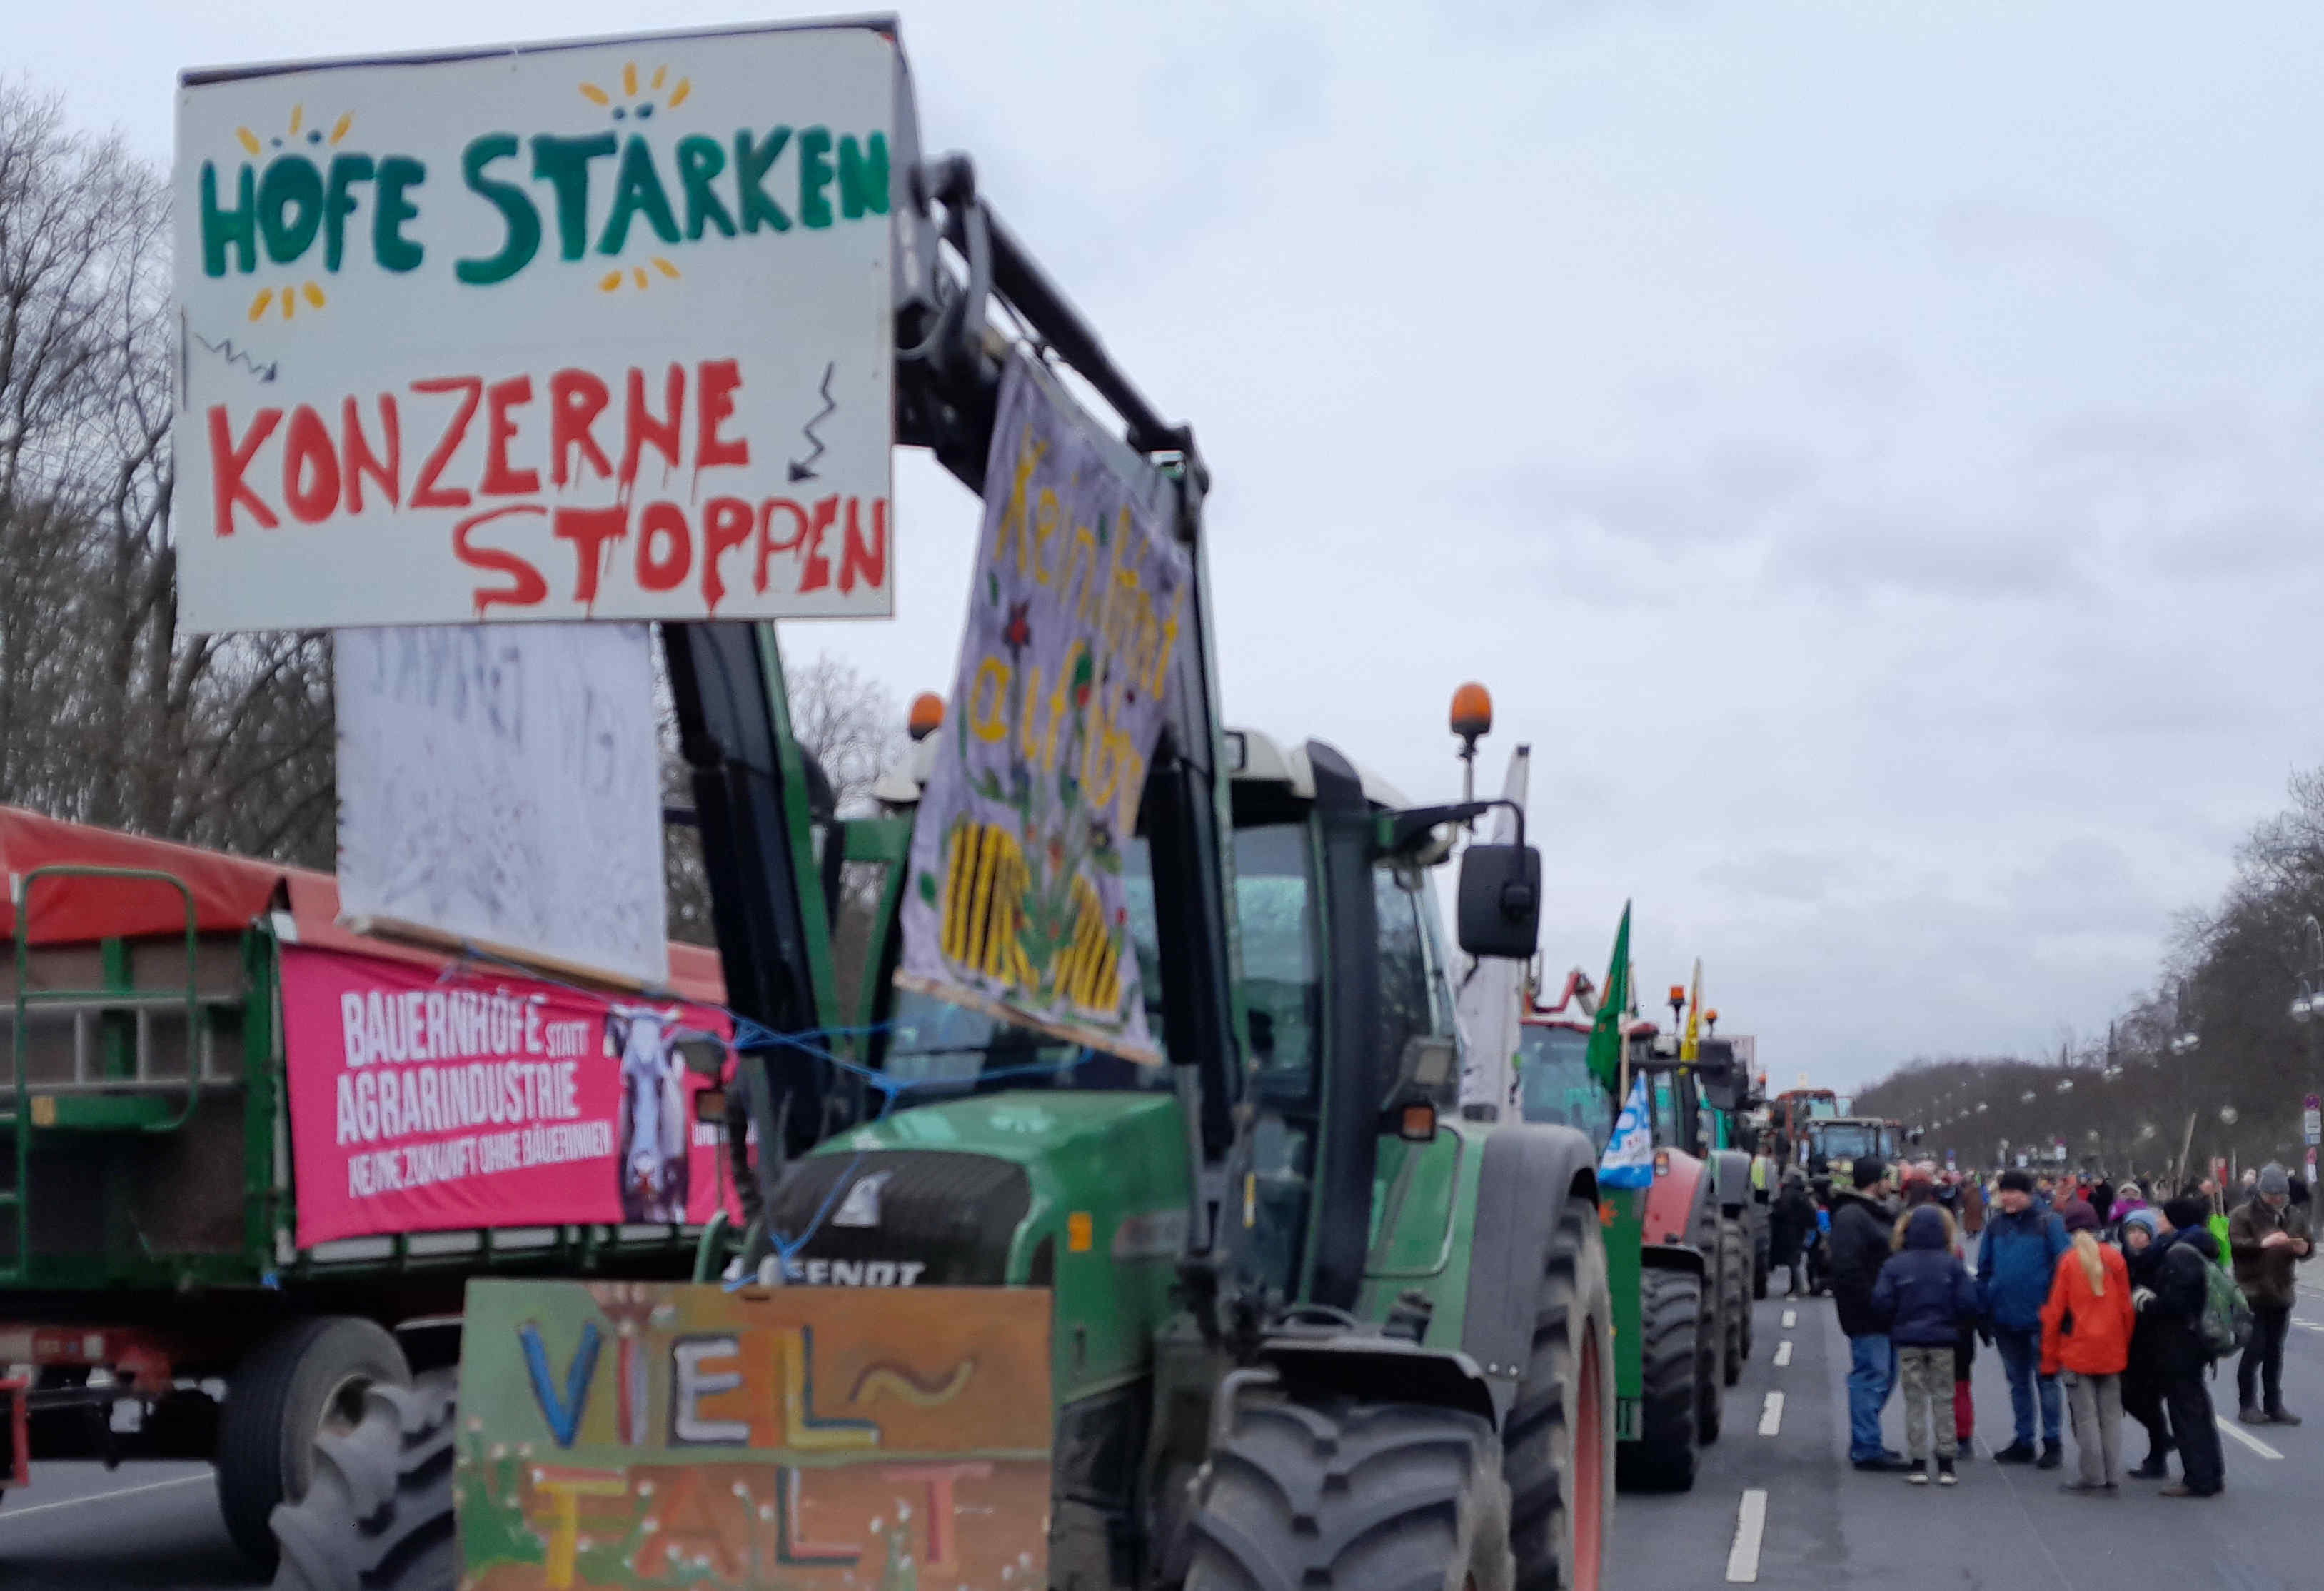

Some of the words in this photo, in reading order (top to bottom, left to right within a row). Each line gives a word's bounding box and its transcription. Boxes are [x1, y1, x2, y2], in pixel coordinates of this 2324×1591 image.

[200, 131, 426, 278] HÖFE
[453, 103, 890, 286] STÄRKEN
[208, 358, 748, 538] KONZERNE
[453, 494, 887, 613] STOPPEN
[341, 986, 548, 1069] BAUERNHÖFE
[546, 1020, 590, 1059] STATT
[336, 1060, 581, 1144] AGRARINDUSTRIE
